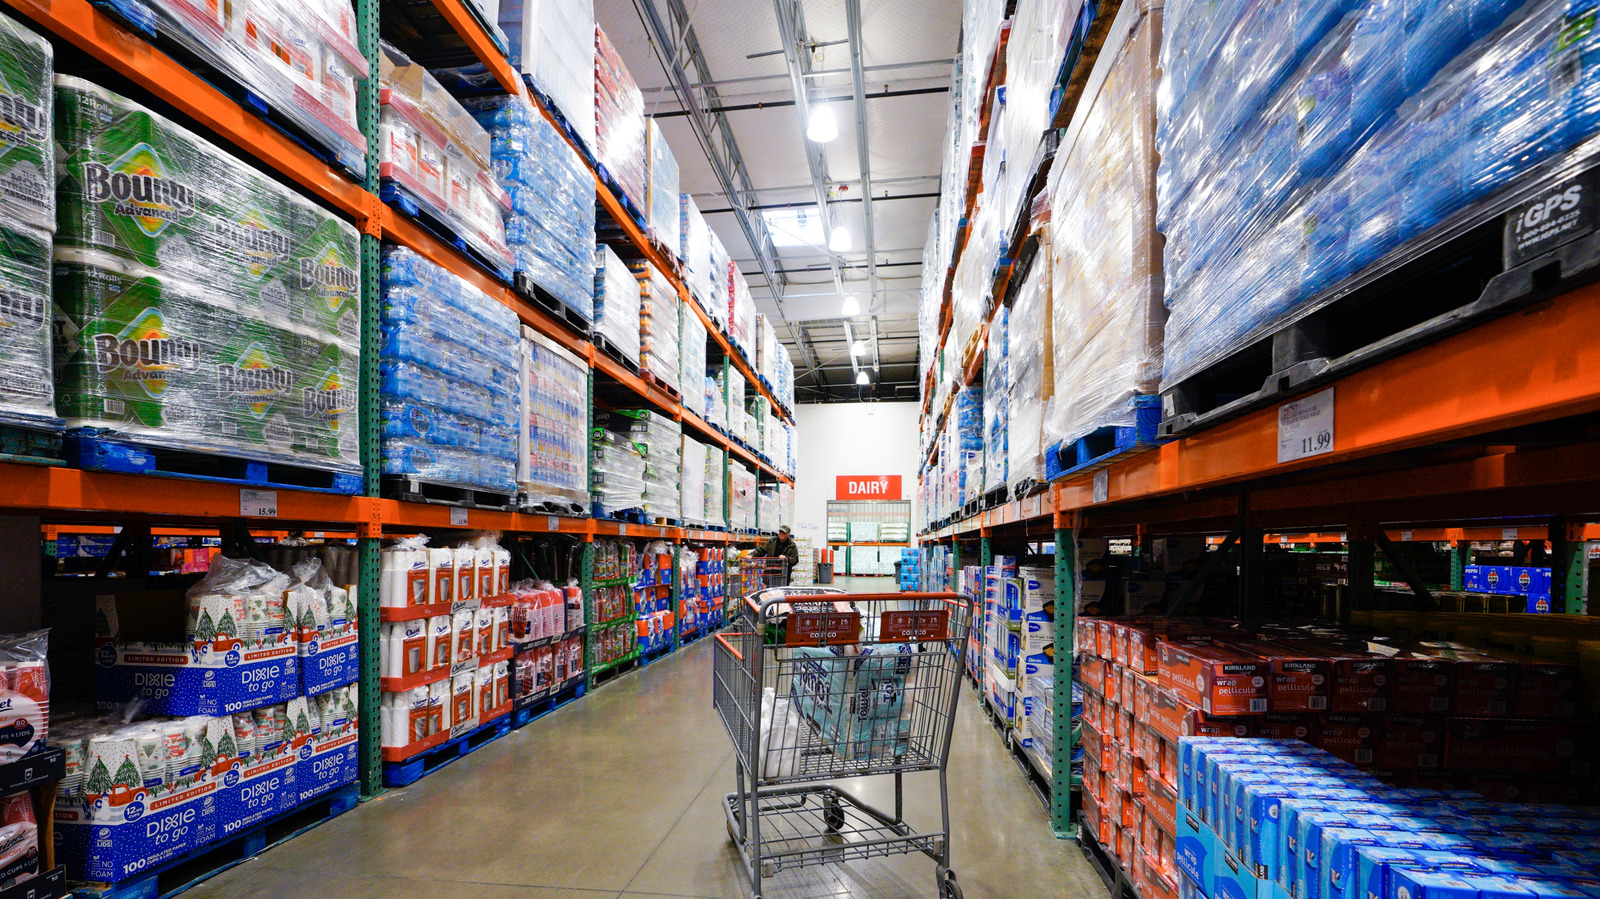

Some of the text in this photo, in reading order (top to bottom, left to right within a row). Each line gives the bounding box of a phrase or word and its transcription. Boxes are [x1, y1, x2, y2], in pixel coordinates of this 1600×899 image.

[114, 201, 179, 220] Advanced
[1515, 184, 1583, 234] iGPS
[300, 258, 358, 295] Bounty
[1302, 431, 1331, 454] 11.99
[848, 481, 888, 494] DAIRY
[258, 507, 276, 516] 15.99
[247, 648, 293, 660] LIMITED EDITION
[324, 665, 343, 677] to go
[1159, 666, 1195, 689] wrap pellicule
[1216, 677, 1237, 687] wrap
[1275, 675, 1296, 684] wrap
[1337, 677, 1359, 686] wrap
[1458, 679, 1479, 687] wrap
[248, 680, 275, 692] to go
[308, 684, 321, 695] 100
[1218, 686, 1256, 696] pellicule
[1277, 683, 1316, 692] pellicule
[1339, 684, 1378, 695] pellicule
[1399, 684, 1438, 693] pellicule
[142, 687, 169, 700] to go
[280, 691, 297, 699] FOAM
[1459, 687, 1498, 697] pellicule
[97, 701, 115, 710] 100
[224, 701, 242, 712] 100
[857, 687, 869, 723] Towel
[15, 719, 26, 727] 80
[1150, 709, 1180, 733] wrap pellicule
[16, 730, 31, 738] LIDS
[1200, 726, 1221, 735] wrap
[1259, 728, 1280, 736] wrap
[1322, 728, 1343, 737] wrap
[1385, 732, 1407, 740] wrap
[1324, 736, 1362, 746] pellicule
[1387, 740, 1426, 749] pellicule
[1453, 745, 1549, 757] wrap pellicule
[246, 756, 294, 776] LIMITED EDITION
[318, 766, 340, 780] to go
[154, 784, 213, 808] LIMITED EDITION
[248, 792, 275, 809] to go
[287, 791, 296, 799] NO
[300, 790, 314, 801] 100
[279, 800, 297, 810] FOAM
[205, 824, 216, 833] NO
[224, 820, 242, 833] 100
[155, 825, 189, 845] to go
[195, 832, 216, 846] FOAM
[1184, 847, 1197, 866] wrap
[101, 860, 114, 868] NO
[122, 858, 146, 875] 100
[1176, 851, 1200, 880] pellicule
[6, 864, 24, 876] CUPS
[90, 869, 114, 878] FOAM
